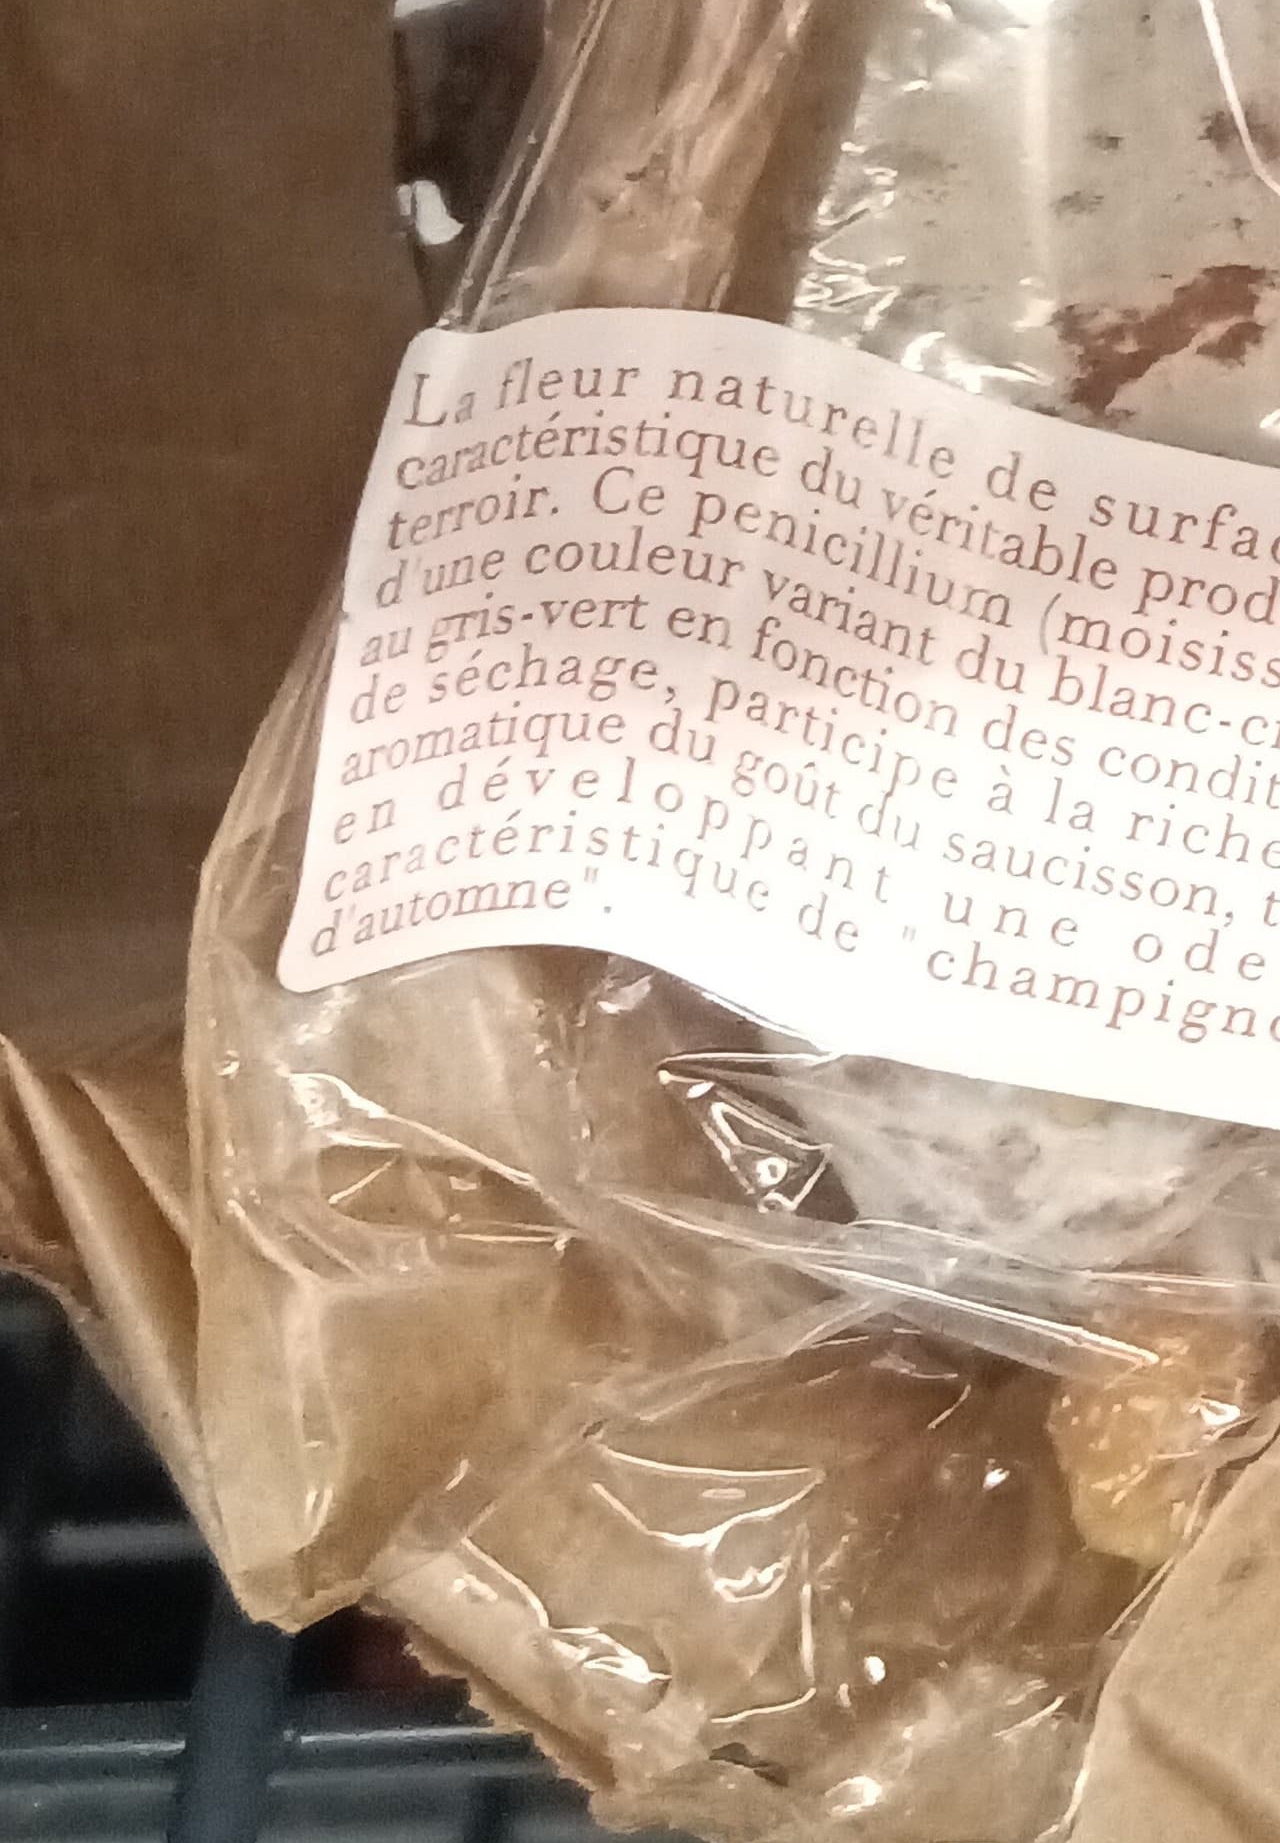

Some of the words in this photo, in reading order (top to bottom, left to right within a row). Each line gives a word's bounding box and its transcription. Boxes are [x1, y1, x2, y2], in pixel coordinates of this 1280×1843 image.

[397, 410, 781, 490] caractéristique
[801, 446, 861, 509] du
[883, 490, 1118, 590] véritable
[403, 373, 475, 426] La
[494, 357, 641, 410] fleur
[668, 366, 956, 479] naturelle
[987, 452, 1057, 511] de
[376, 549, 505, 608] d'une
[526, 526, 746, 588] couleur
[761, 568, 937, 665] variant
[956, 634, 1027, 696] du
[388, 474, 559, 550] terroir.
[593, 466, 666, 516] Ce
[689, 488, 1014, 627] penicillium
[350, 674, 407, 724] de
[428, 642, 677, 706] séchage,
[706, 676, 958, 799] participe
[987, 765, 1014, 814] à
[1045, 777, 1095, 832] la
[360, 625, 414, 666] au
[425, 591, 649, 663] gris-vert
[667, 606, 732, 649] en
[751, 617, 959, 738] fonction
[983, 704, 1075, 768] des
[324, 809, 770, 914] caractéristique
[798, 892, 860, 952] de
[334, 798, 396, 844] en
[437, 756, 891, 904] développant
[944, 890, 1080, 947] une
[341, 700, 627, 787] aromatique
[649, 708, 717, 764] du
[730, 750, 841, 818] goût
[857, 789, 920, 851] du
[943, 829, 1234, 928] saucisson,
